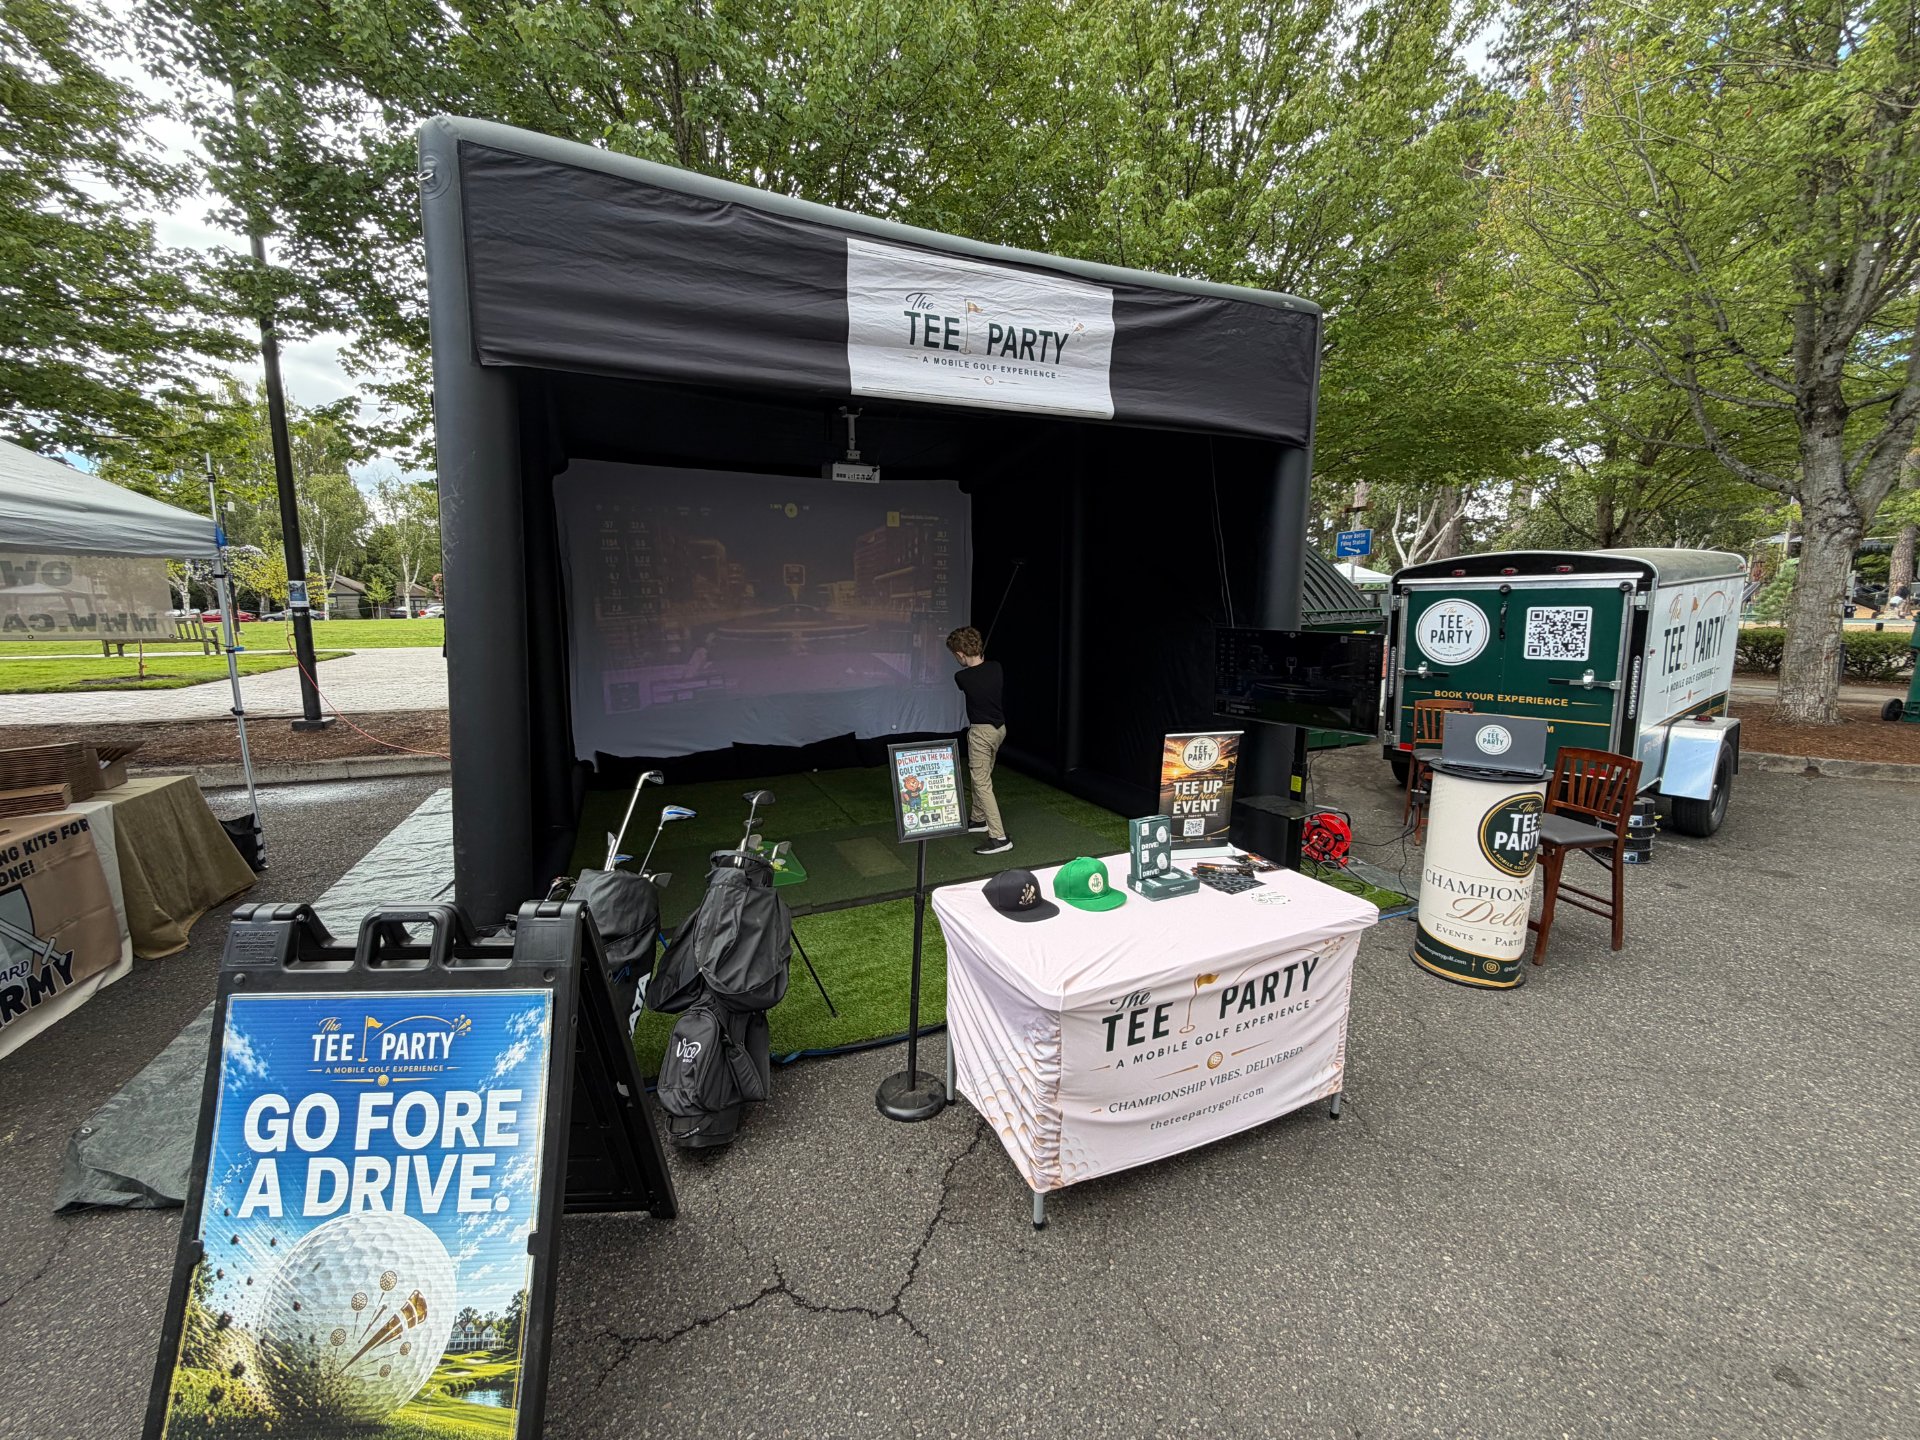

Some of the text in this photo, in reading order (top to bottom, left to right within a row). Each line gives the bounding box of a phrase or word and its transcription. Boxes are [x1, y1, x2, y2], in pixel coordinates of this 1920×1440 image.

[905, 292, 935, 310] The
[904, 311, 1069, 365] TEE PARTY
[934, 357, 970, 368] MOBILE
[973, 362, 998, 372] GOLF
[1001, 366, 1057, 379] EXPERIENCE
[1439, 615, 1464, 629] TEE
[1430, 629, 1473, 644] PARTY
[1662, 614, 1727, 676] TEE PARTY
[1434, 690, 1569, 707] BOOK YOUR EXPERIENCE
[1193, 745, 1209, 754] TEE
[1482, 737, 1504, 746] PARTY
[920, 754, 927, 763] IN
[928, 753, 938, 761] THE
[1187, 752, 1213, 761] PARTY
[1173, 780, 1223, 796] TEE UP
[1172, 798, 1220, 815] EVENT
[1519, 801, 1536, 812] The
[1510, 813, 1538, 832] TEE
[22, 831, 58, 856] KITS
[60, 818, 90, 840] FOR
[1493, 829, 1541, 851] PARTY
[1102, 957, 1320, 1053] TEE PARTY
[1109, 987, 1152, 1013] The
[318, 1016, 342, 1033] The
[1116, 1001, 1310, 1069] A MOBILE GOLF EXPERIENCE
[312, 1031, 456, 1062] TEE PARTY
[676, 1037, 702, 1058] Vice
[325, 1064, 444, 1074] A MOBILE GOLF EXPERIENCE
[1108, 1080, 1207, 1114] CHAMPIONSHIP
[1209, 1069, 1243, 1088] VIBES.
[1150, 1086, 1265, 1131] theteepartygolf.com
[243, 1088, 523, 1152] GO FORE
[237, 1153, 510, 1219] A DRIVE.
